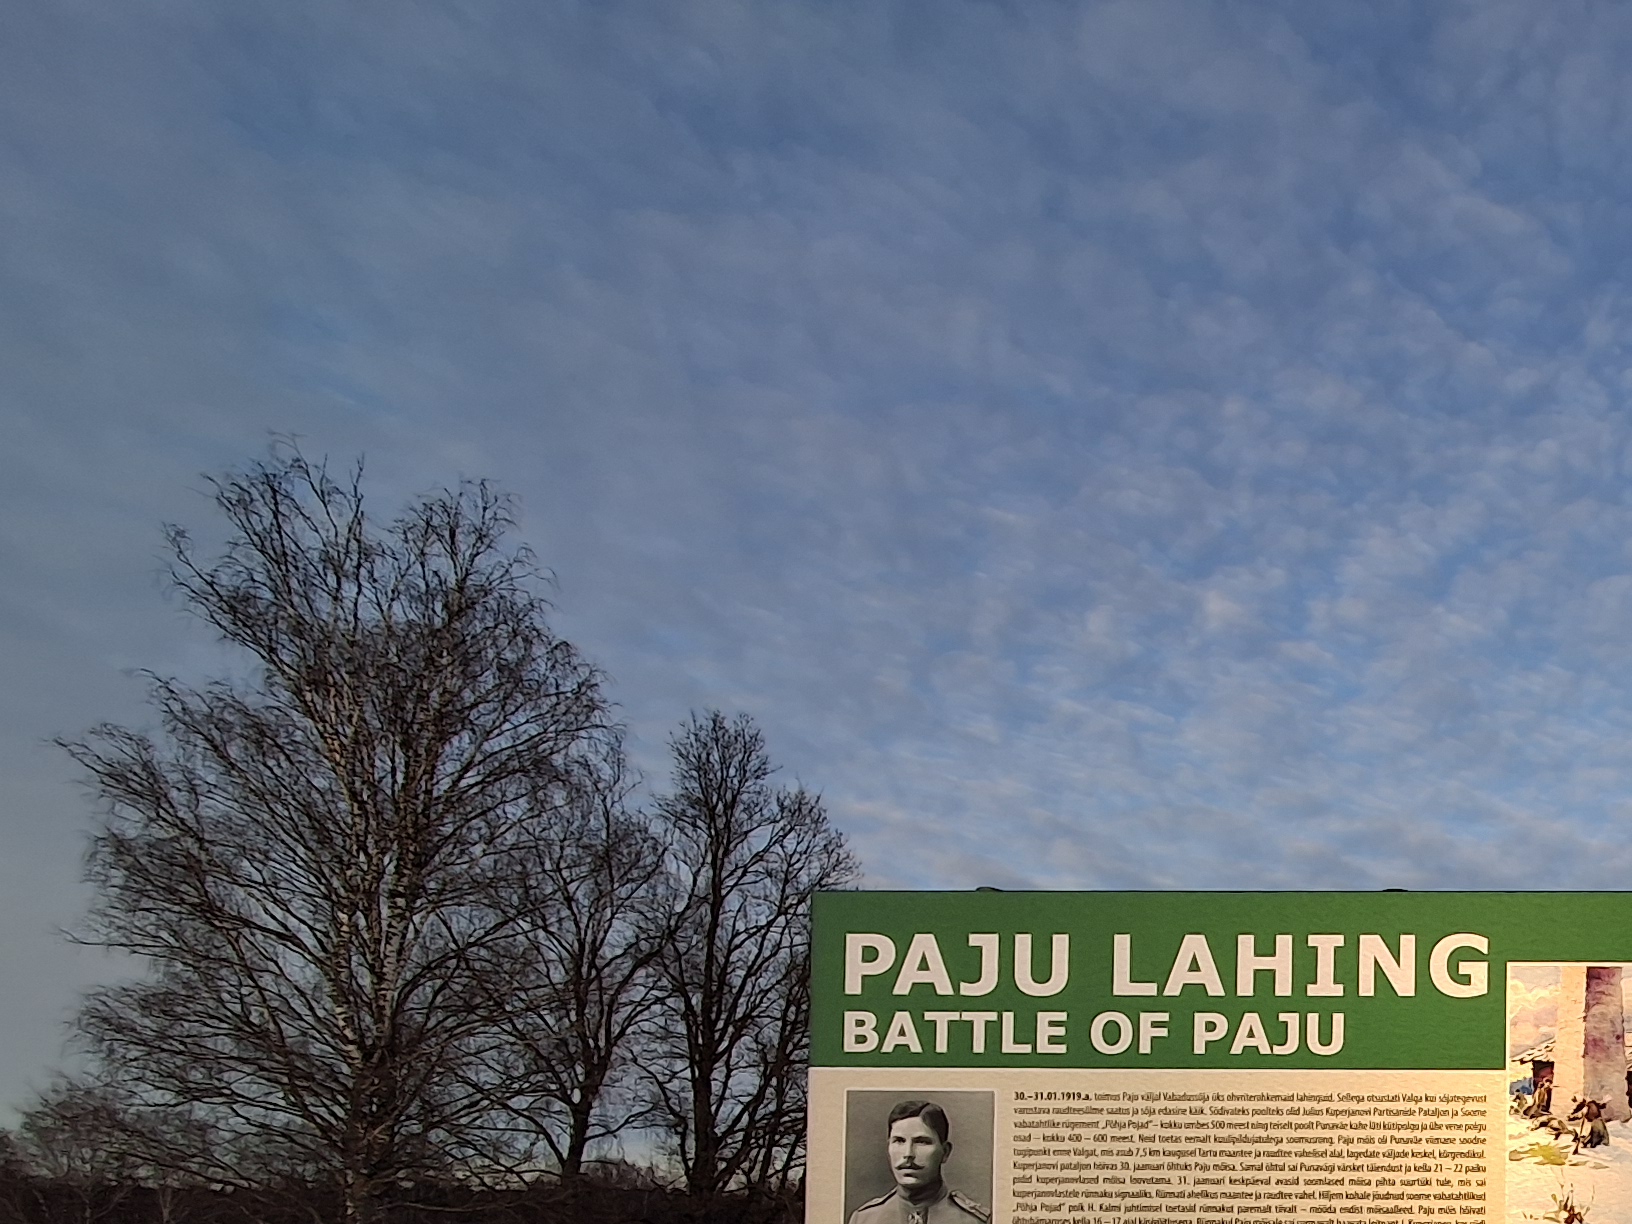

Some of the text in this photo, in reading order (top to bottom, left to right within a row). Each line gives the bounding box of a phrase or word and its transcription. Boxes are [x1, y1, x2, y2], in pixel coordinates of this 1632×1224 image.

[843, 932, 1491, 998] PAJU LAHING
[842, 1011, 1346, 1056] BATTLE OF PAJU
[1178, 1176, 1189, 1185] 31.
